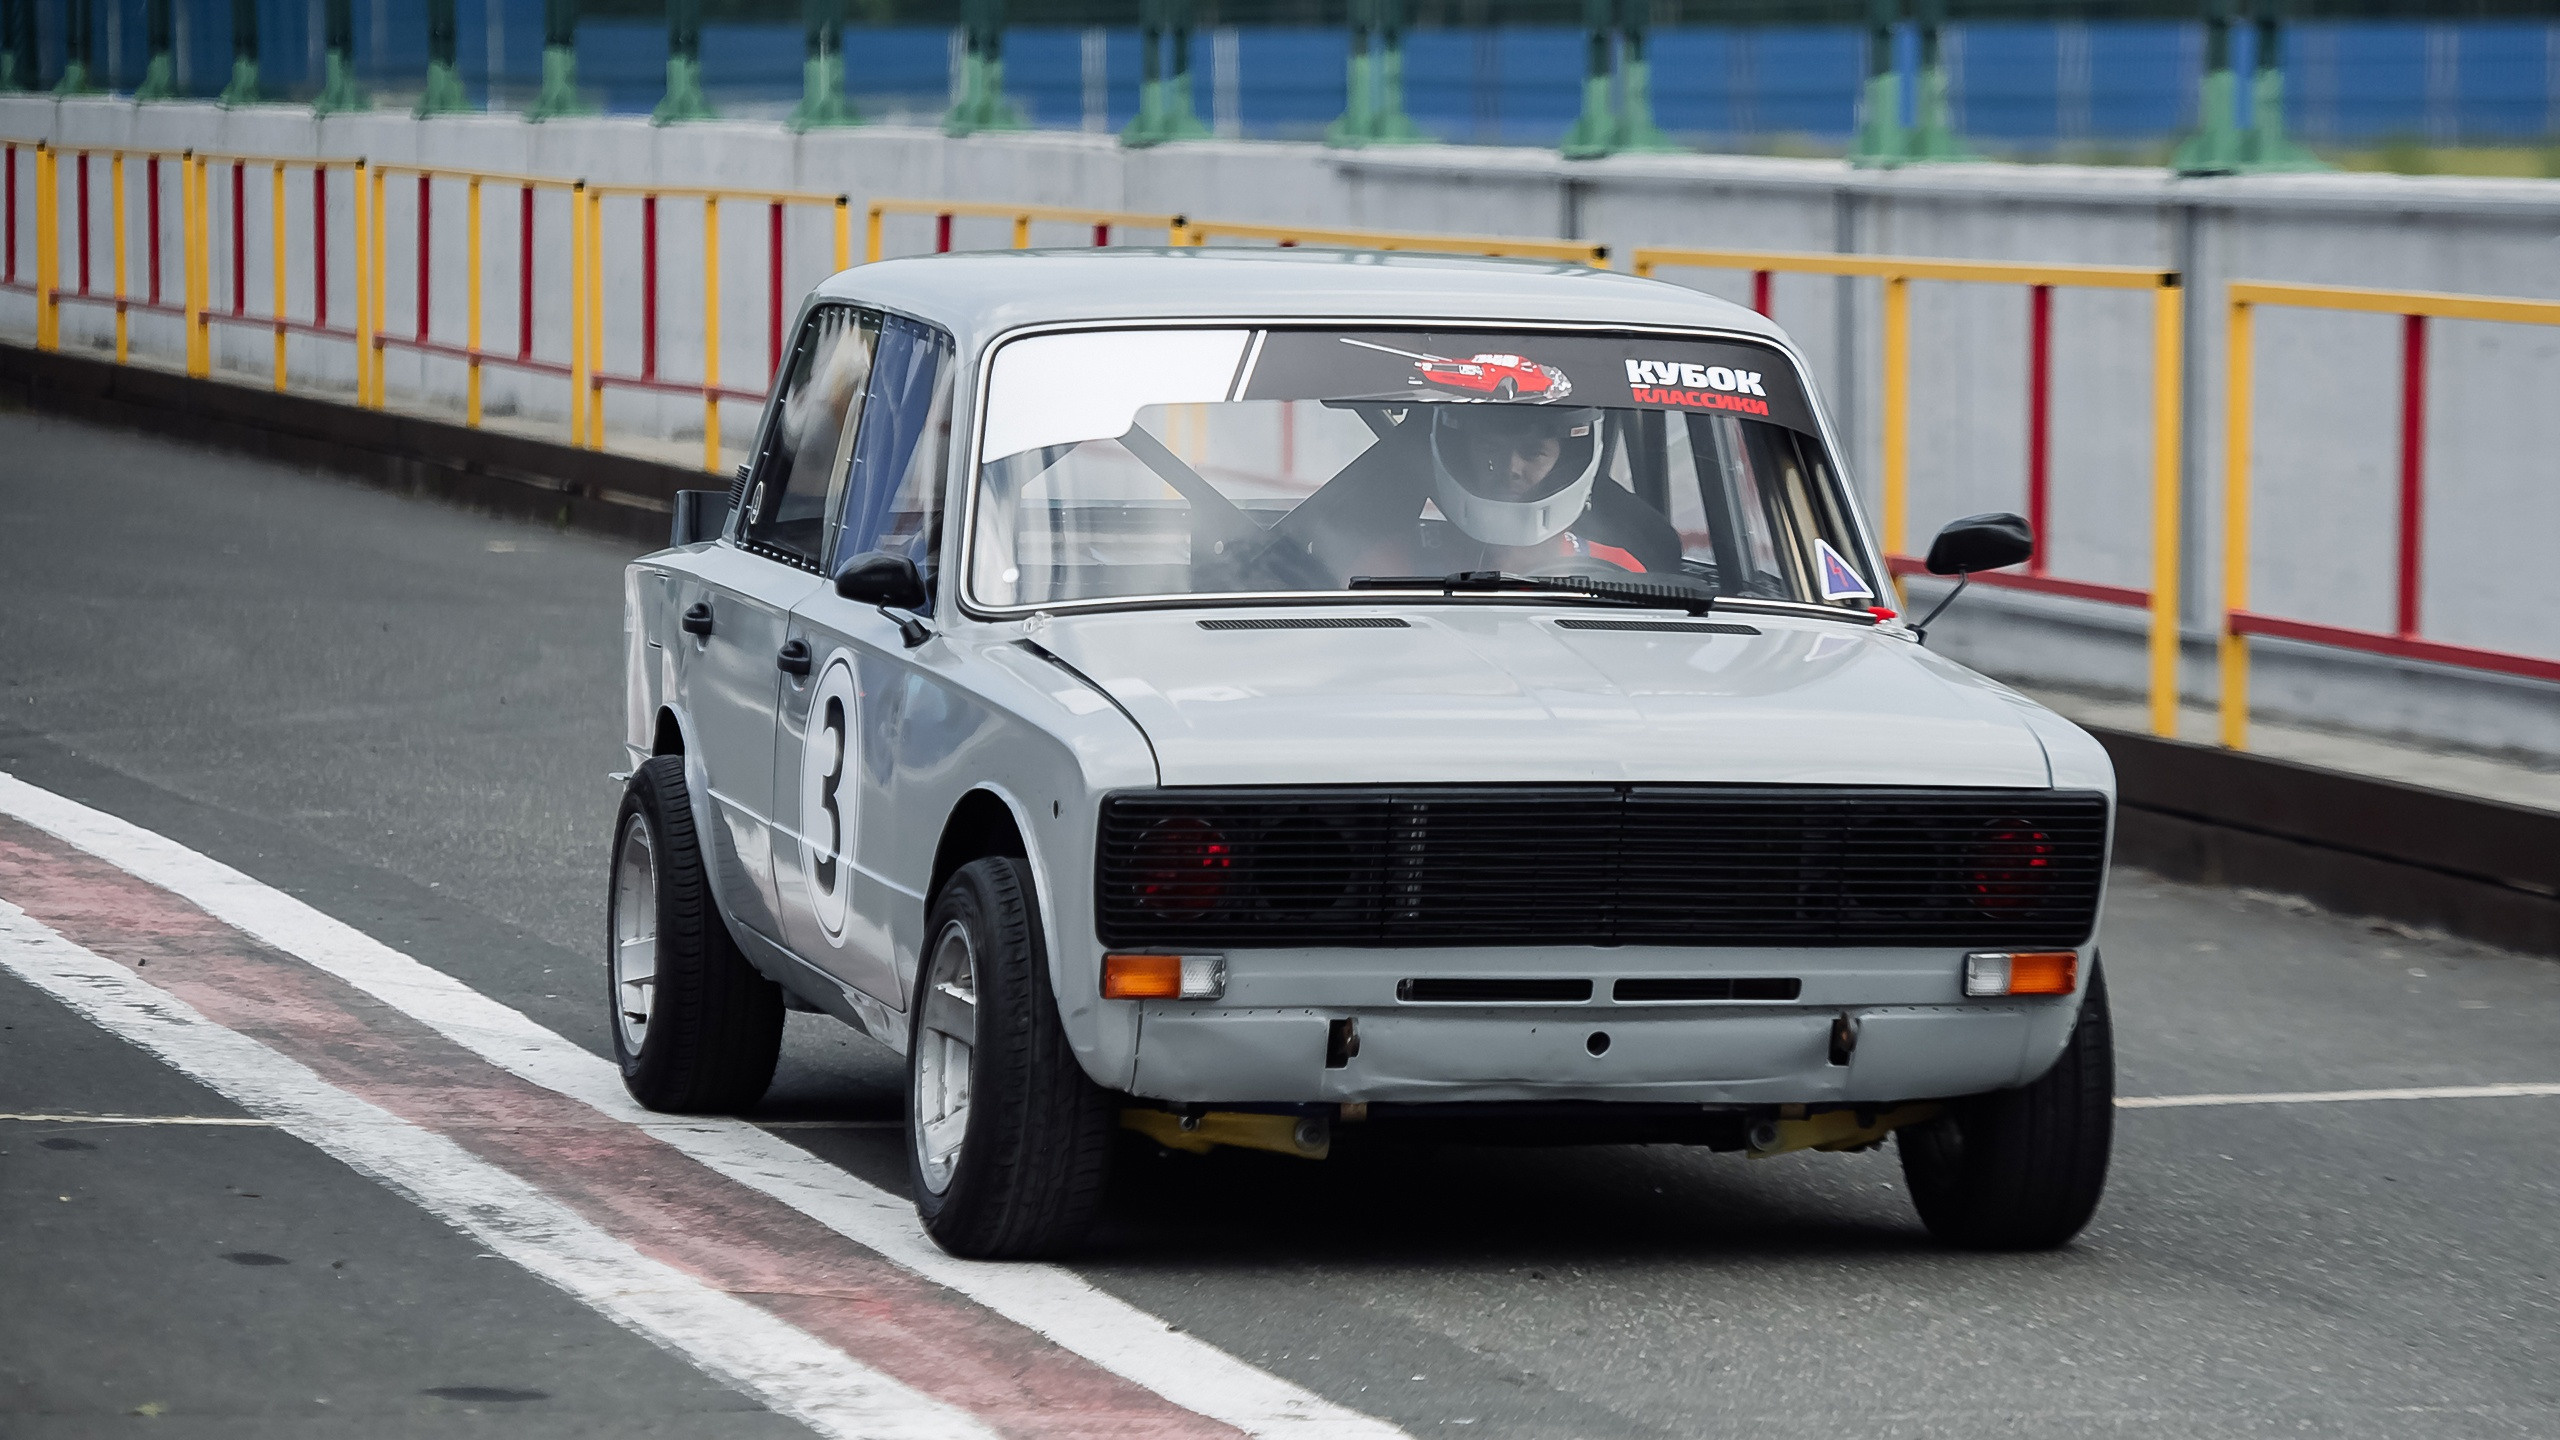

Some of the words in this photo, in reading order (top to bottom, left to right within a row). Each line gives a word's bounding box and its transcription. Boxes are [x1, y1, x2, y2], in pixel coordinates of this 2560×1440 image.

[1625, 359, 1767, 396] КУБОК
[1632, 388, 1769, 416] КЛАССИКИ
[813, 695, 846, 897] 3
